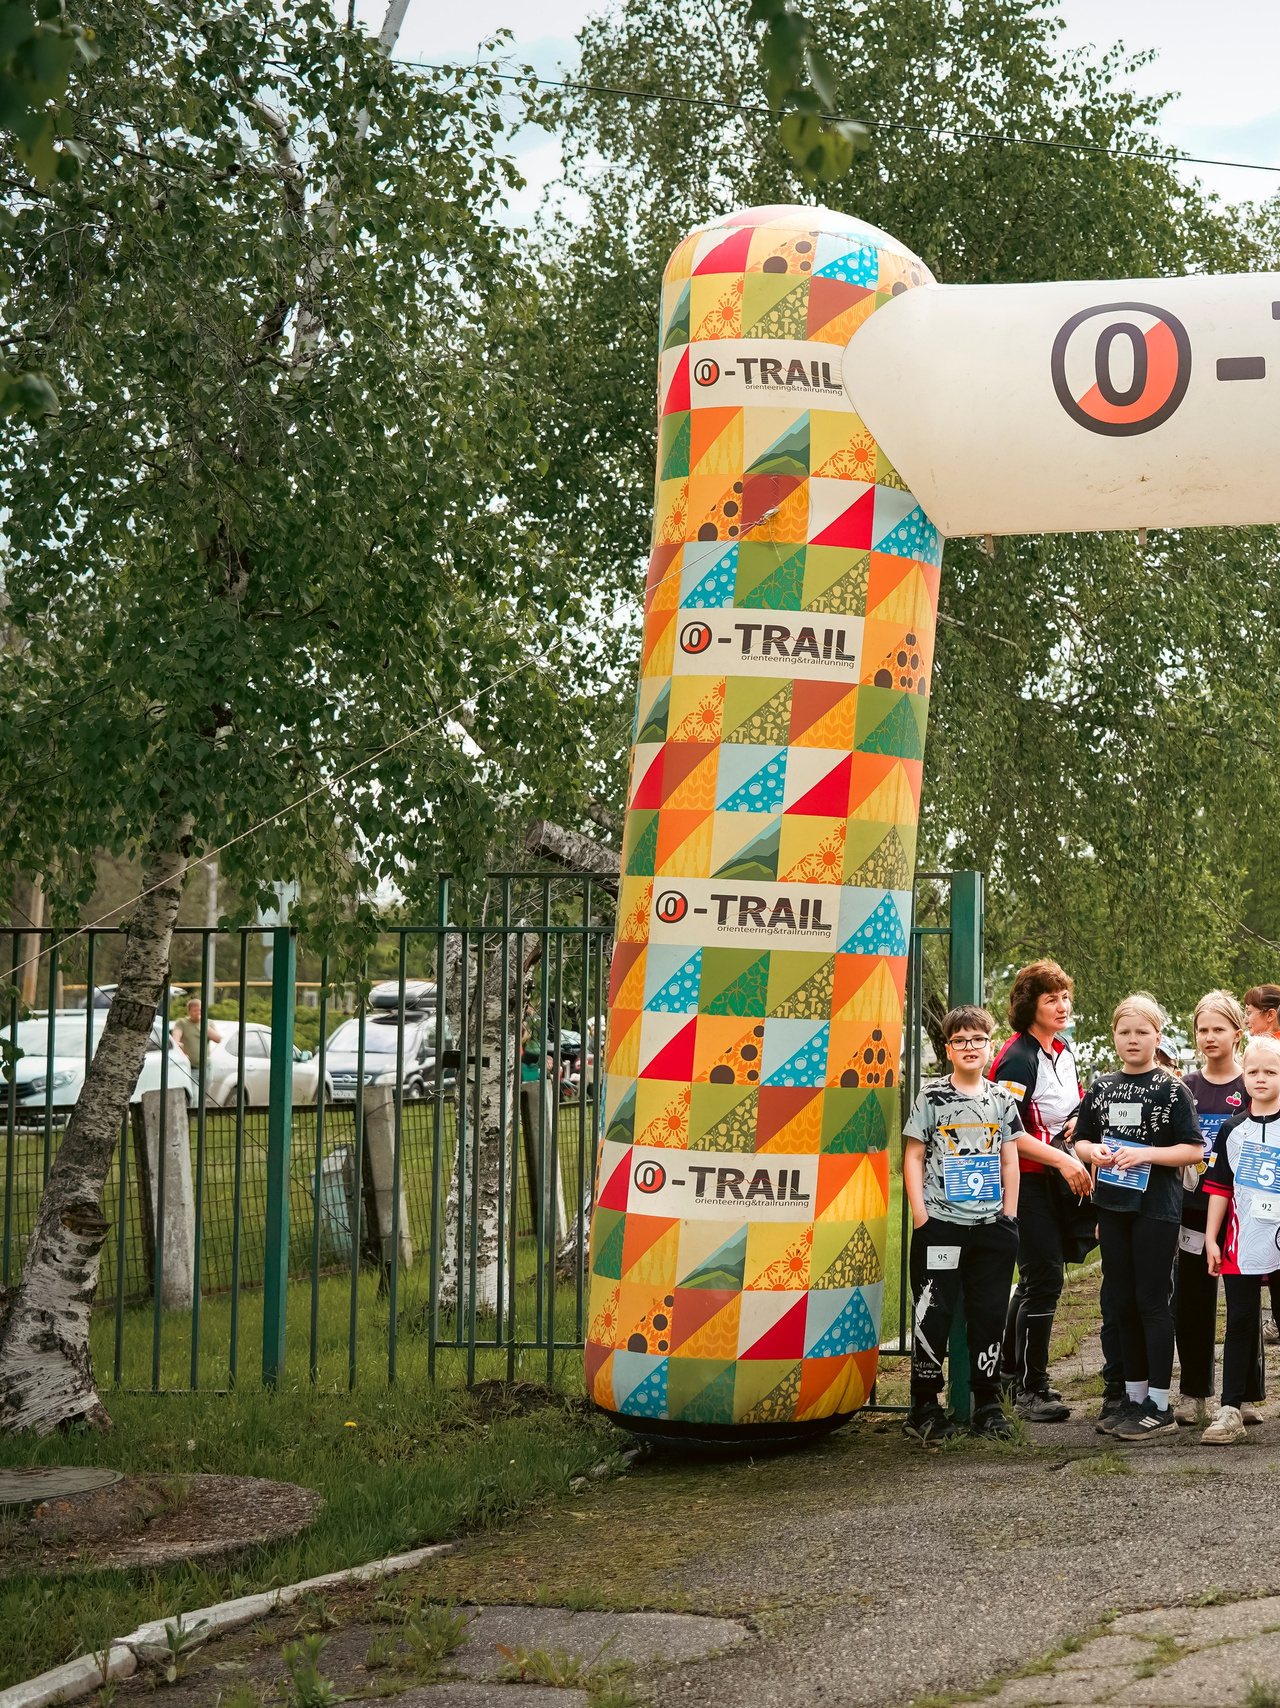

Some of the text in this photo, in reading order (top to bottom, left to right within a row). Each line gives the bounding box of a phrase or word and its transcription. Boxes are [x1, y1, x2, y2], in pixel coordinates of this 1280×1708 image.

[745, 384, 843, 396] orienteering&trailrunning
[741, 654, 855, 669] orienteering&trailrunning
[717, 926, 832, 939] orienteering&trailrunning
[1118, 1110, 1128, 1118] 90
[1256, 1161, 1276, 1187] 5
[967, 1172, 985, 1197] 9
[695, 1198, 810, 1208] orienteering&trailrunning
[1262, 1203, 1272, 1212] 92
[938, 1252, 948, 1262] 95
